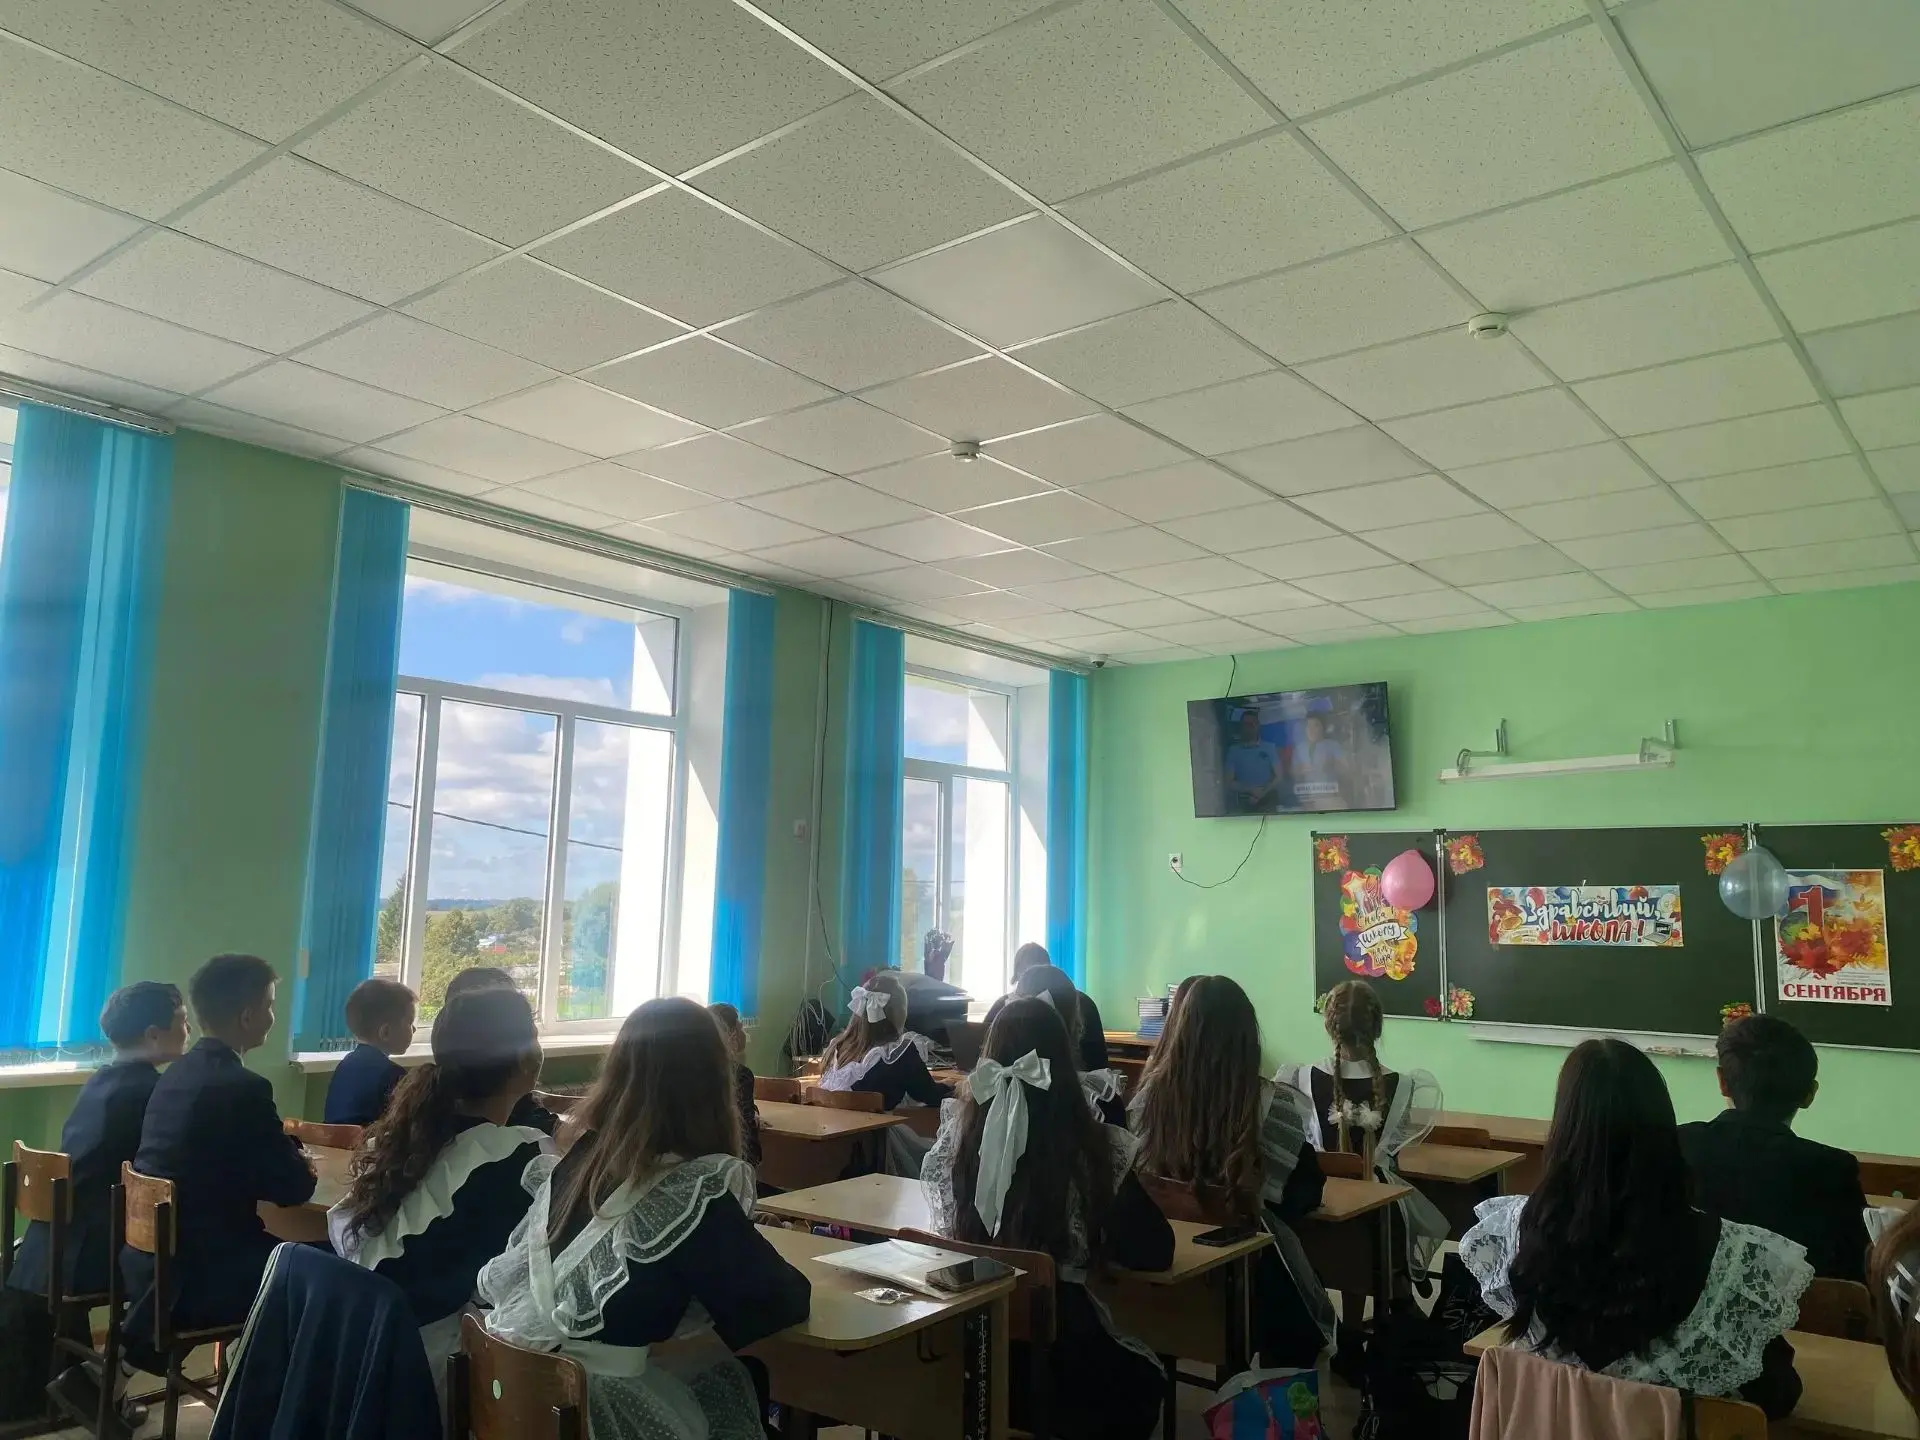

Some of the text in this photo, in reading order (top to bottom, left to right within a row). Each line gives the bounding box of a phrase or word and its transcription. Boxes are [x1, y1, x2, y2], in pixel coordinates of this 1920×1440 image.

[1526, 887, 1660, 930] Здравствуй,
[1799, 885, 1824, 936] 1
[1552, 919, 1645, 944] ШКОЛА!
[1783, 983, 1887, 1002] СЕНТЯБРЯ
